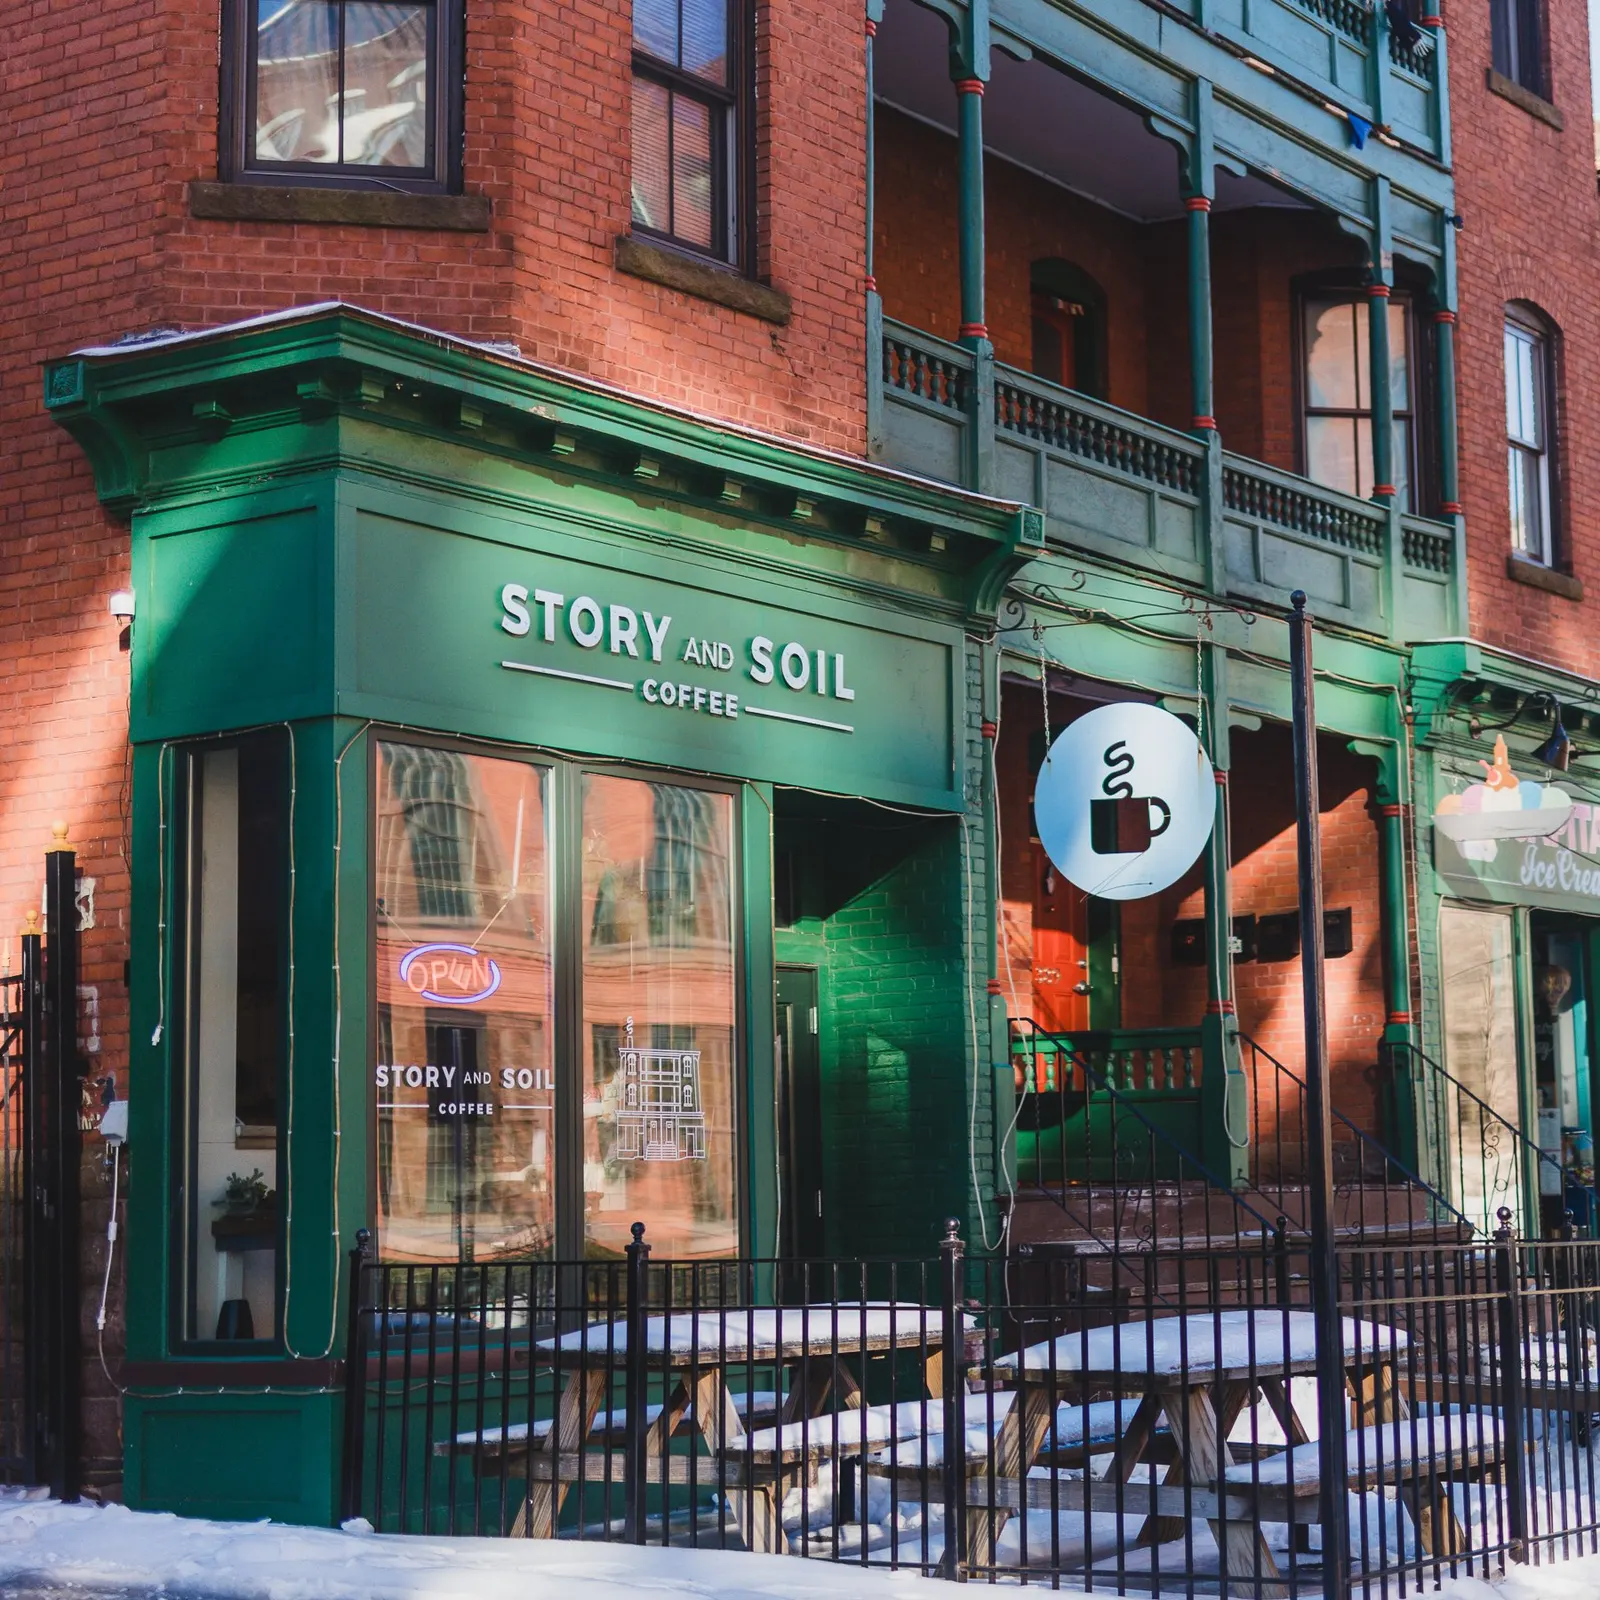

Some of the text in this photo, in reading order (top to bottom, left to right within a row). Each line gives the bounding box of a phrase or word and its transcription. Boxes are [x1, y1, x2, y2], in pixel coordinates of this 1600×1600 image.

[501, 583, 855, 701] STORY AND SOIL
[642, 678, 739, 718] COFFEE
[1520, 844, 1557, 888] Ice
[407, 957, 491, 993] OPEN
[376, 1064, 555, 1090] STORY AND SOIL
[438, 1103, 494, 1115] COFFEE
